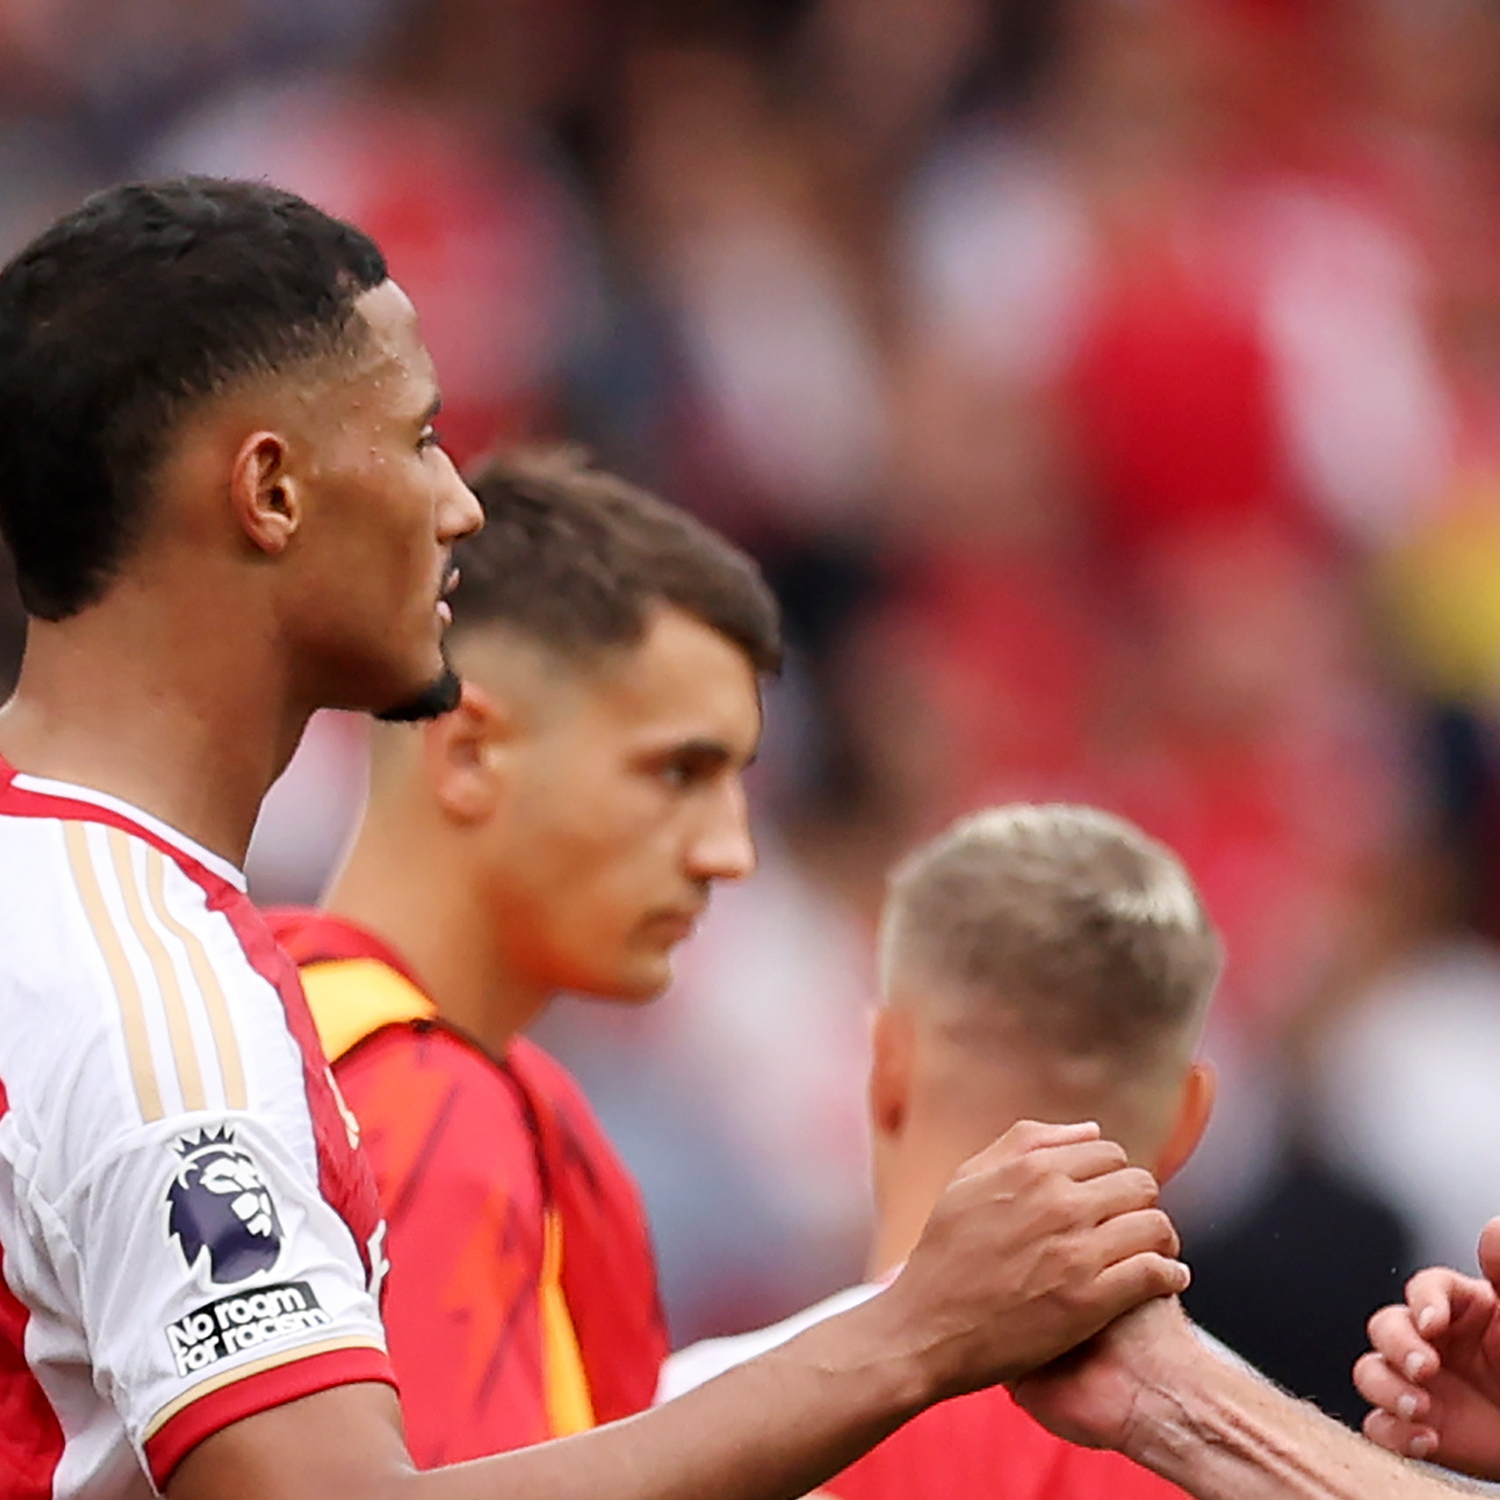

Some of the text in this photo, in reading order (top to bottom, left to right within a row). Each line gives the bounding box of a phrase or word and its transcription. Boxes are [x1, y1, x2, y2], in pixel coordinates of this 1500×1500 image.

[166, 1287, 307, 1350] No room
[175, 1308, 332, 1378] for racism
